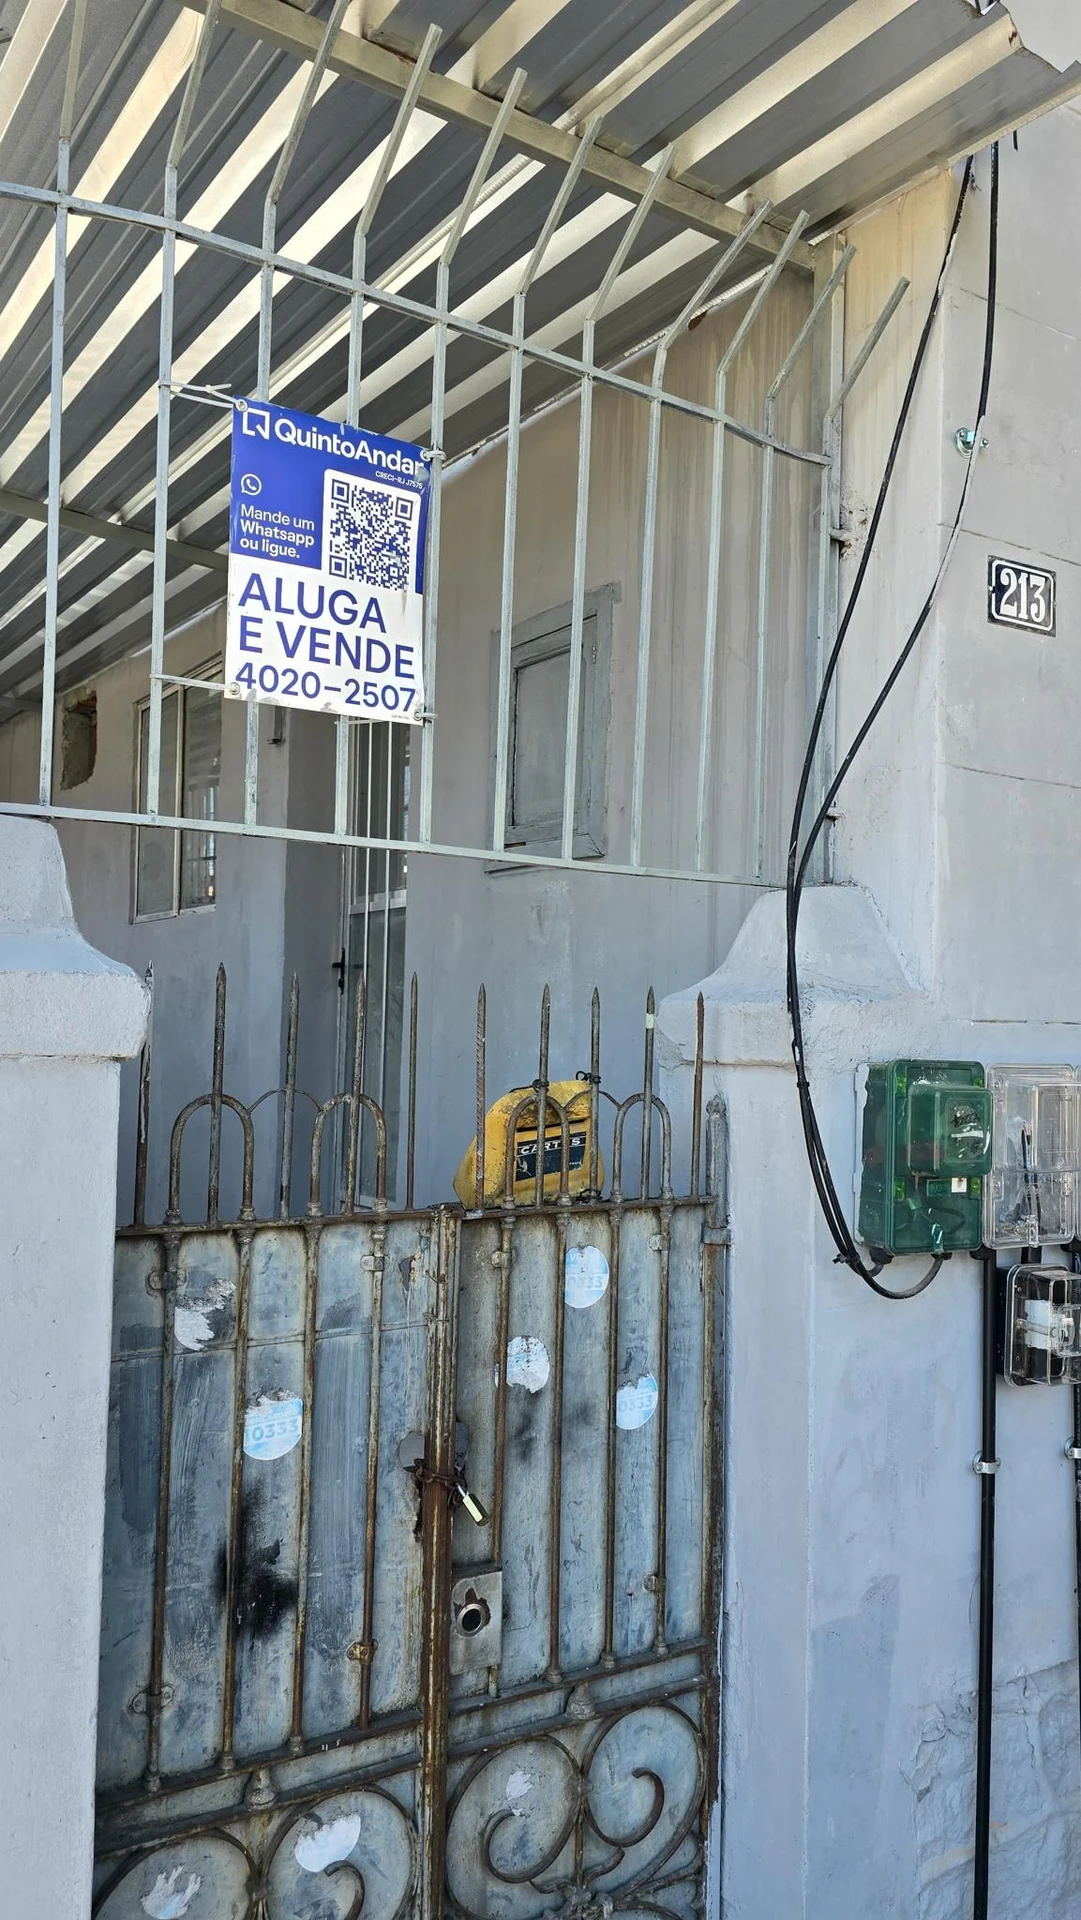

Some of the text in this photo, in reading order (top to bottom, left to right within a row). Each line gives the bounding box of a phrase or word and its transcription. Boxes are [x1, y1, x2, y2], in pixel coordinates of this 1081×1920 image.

[274, 418, 425, 476] QuintoAndar
[240, 519, 315, 548] Whatsapp
[241, 503, 315, 531] Mande um
[239, 538, 301, 559] ou ligue.
[238, 572, 387, 634] ALUGA
[1000, 567, 1046, 623] 213
[239, 615, 415, 680] E VENDE
[235, 661, 416, 712] 4020-2507
[520, 1137, 581, 1155] CARTS
